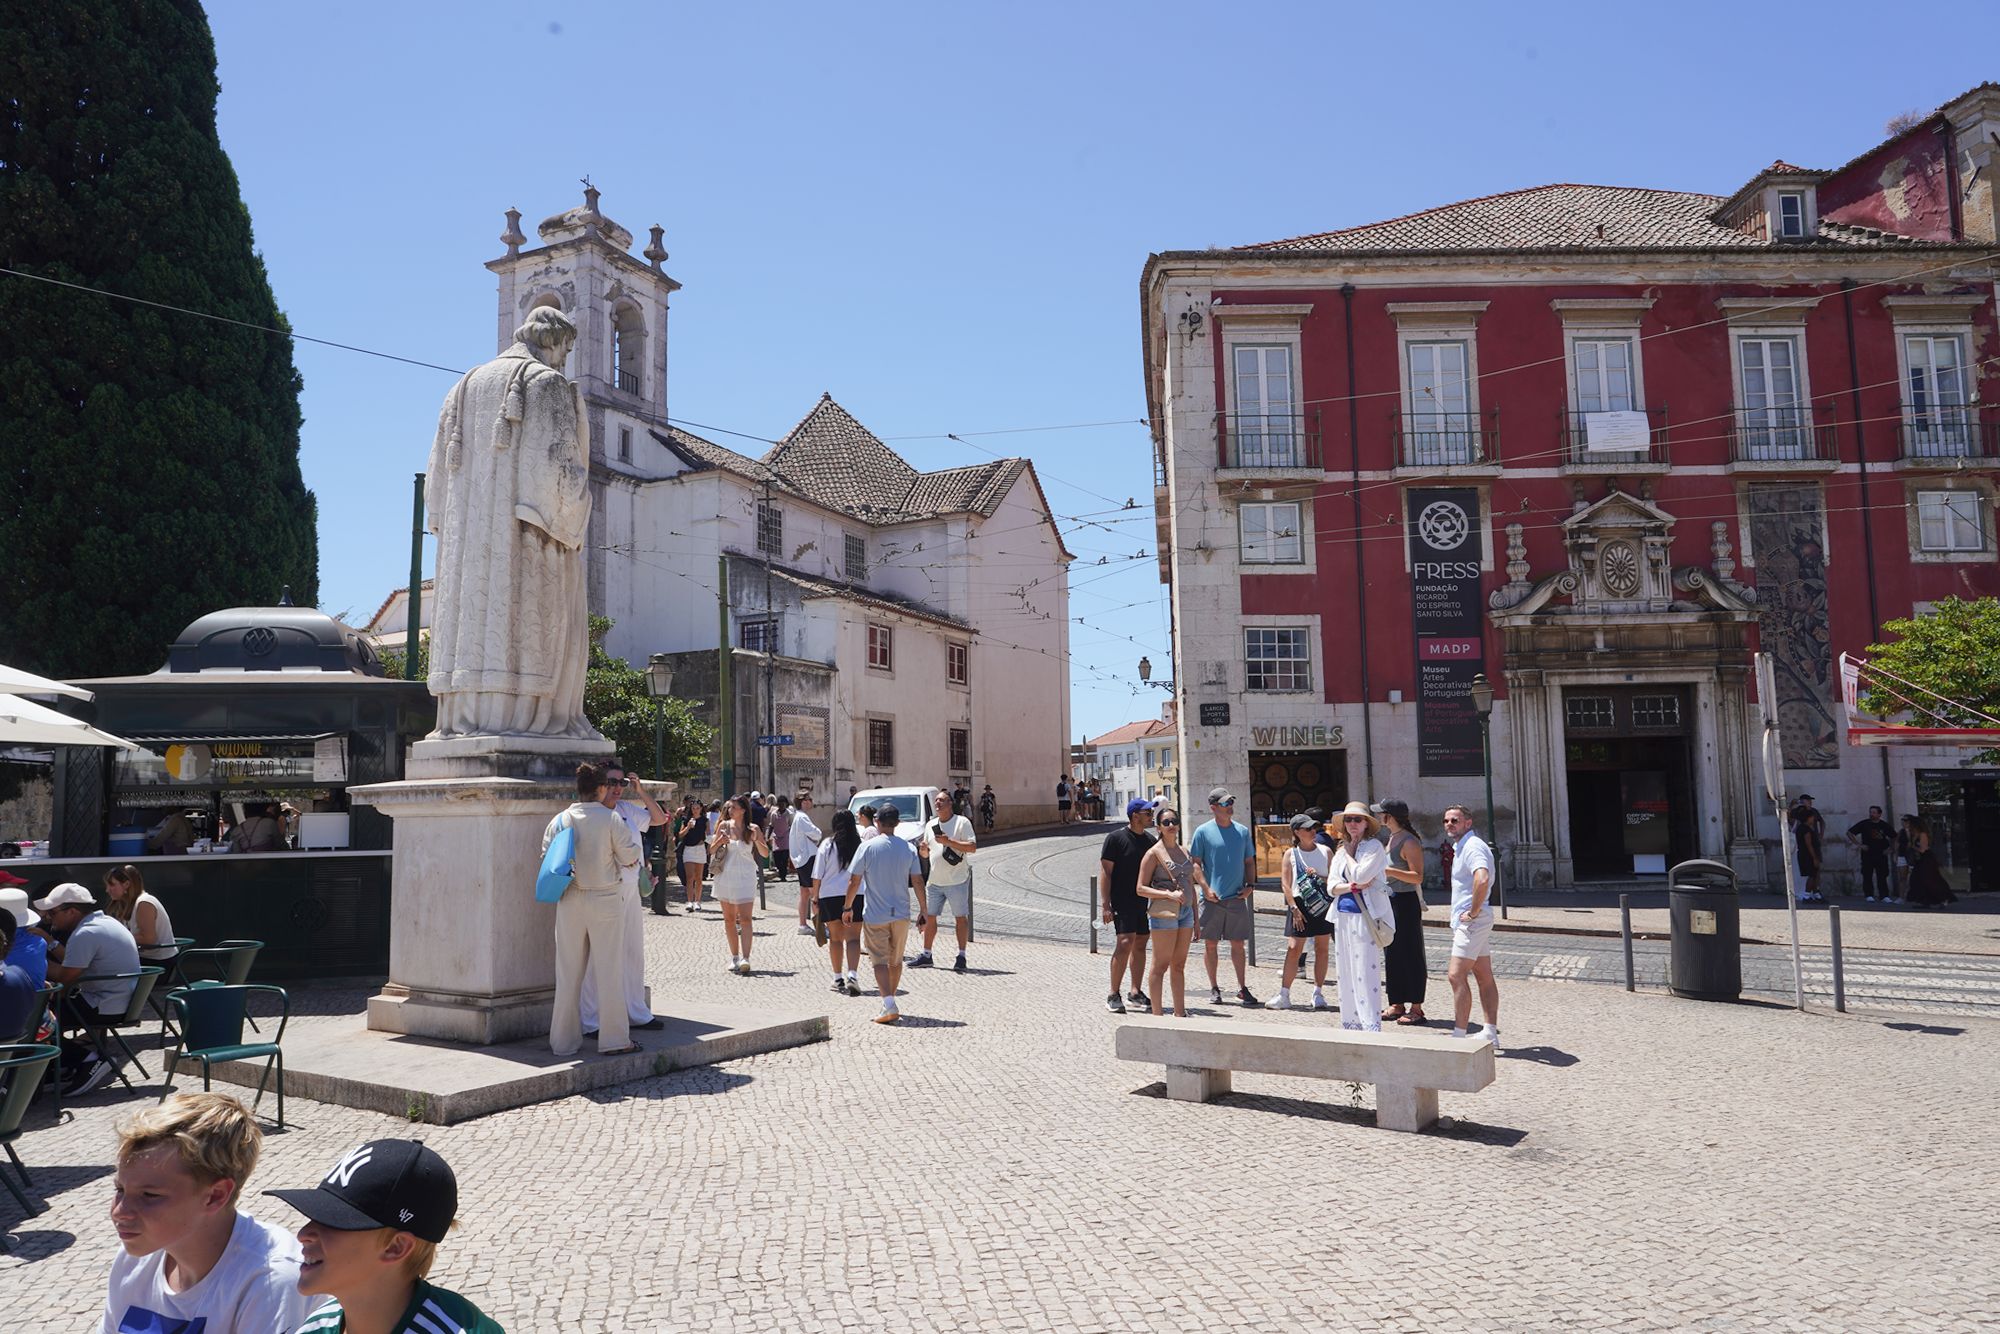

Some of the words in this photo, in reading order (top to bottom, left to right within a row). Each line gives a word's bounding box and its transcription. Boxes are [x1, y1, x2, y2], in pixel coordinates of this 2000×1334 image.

[1414, 561, 1479, 579] FRESS
[1415, 584, 1458, 592] FUNDAÇÃO
[1428, 600, 1461, 609] ESPÍRITO
[1416, 610, 1442, 618] SANTO
[1442, 610, 1464, 618] SILVA
[1429, 644, 1471, 654] MADP
[1423, 681, 1472, 689] Decorativas
[1423, 690, 1472, 698] Portuguesa
[1252, 726, 1343, 746] WINES
[214, 743, 263, 758] QUIOSQUE
